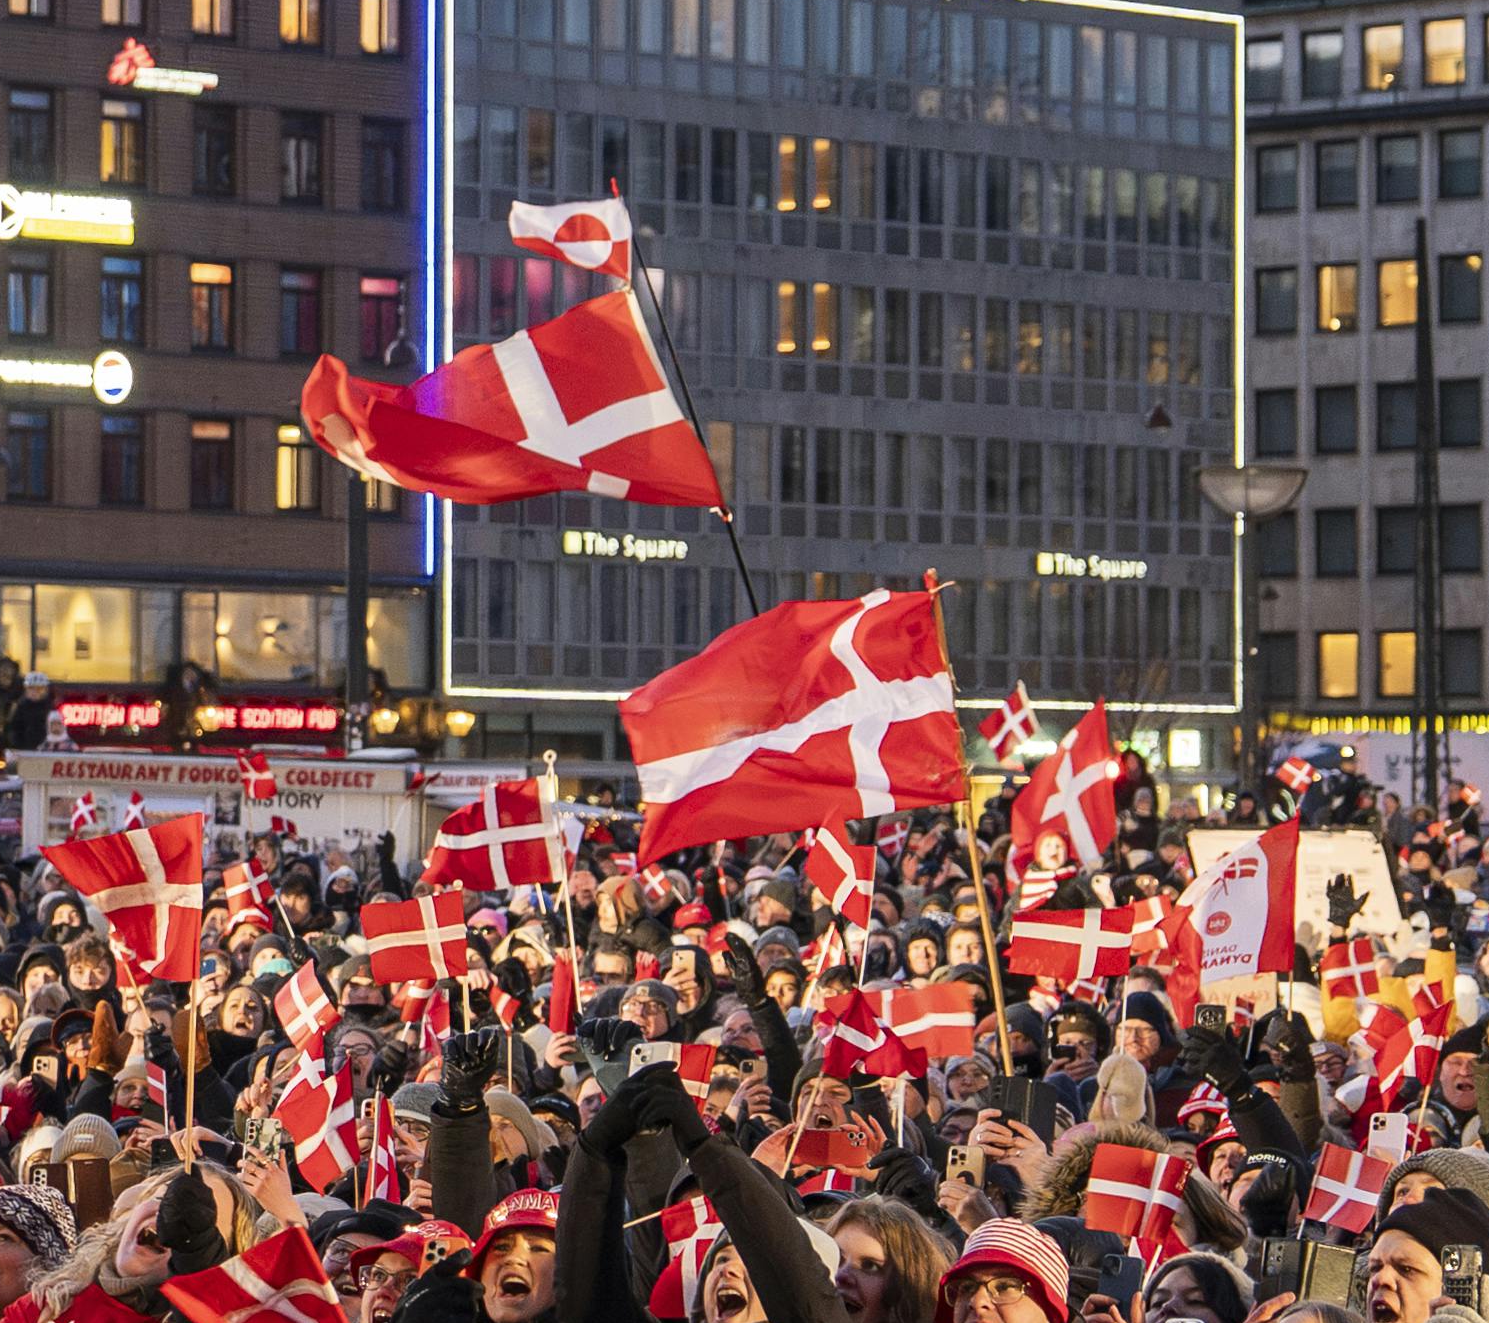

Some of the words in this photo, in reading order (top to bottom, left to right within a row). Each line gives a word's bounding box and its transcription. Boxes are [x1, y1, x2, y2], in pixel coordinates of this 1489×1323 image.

[583, 530, 619, 558] The
[623, 533, 689, 564] Square
[1055, 552, 1086, 576] The
[1089, 555, 1148, 579] Square
[60, 703, 125, 727] SCOTTISH
[127, 704, 161, 728] PUB
[240, 707, 304, 730] SCOTTISH
[306, 707, 338, 731] PUB
[51, 760, 173, 784] RESTAURANT
[178, 765, 243, 785] FODKO
[285, 766, 376, 790] COLDFEET
